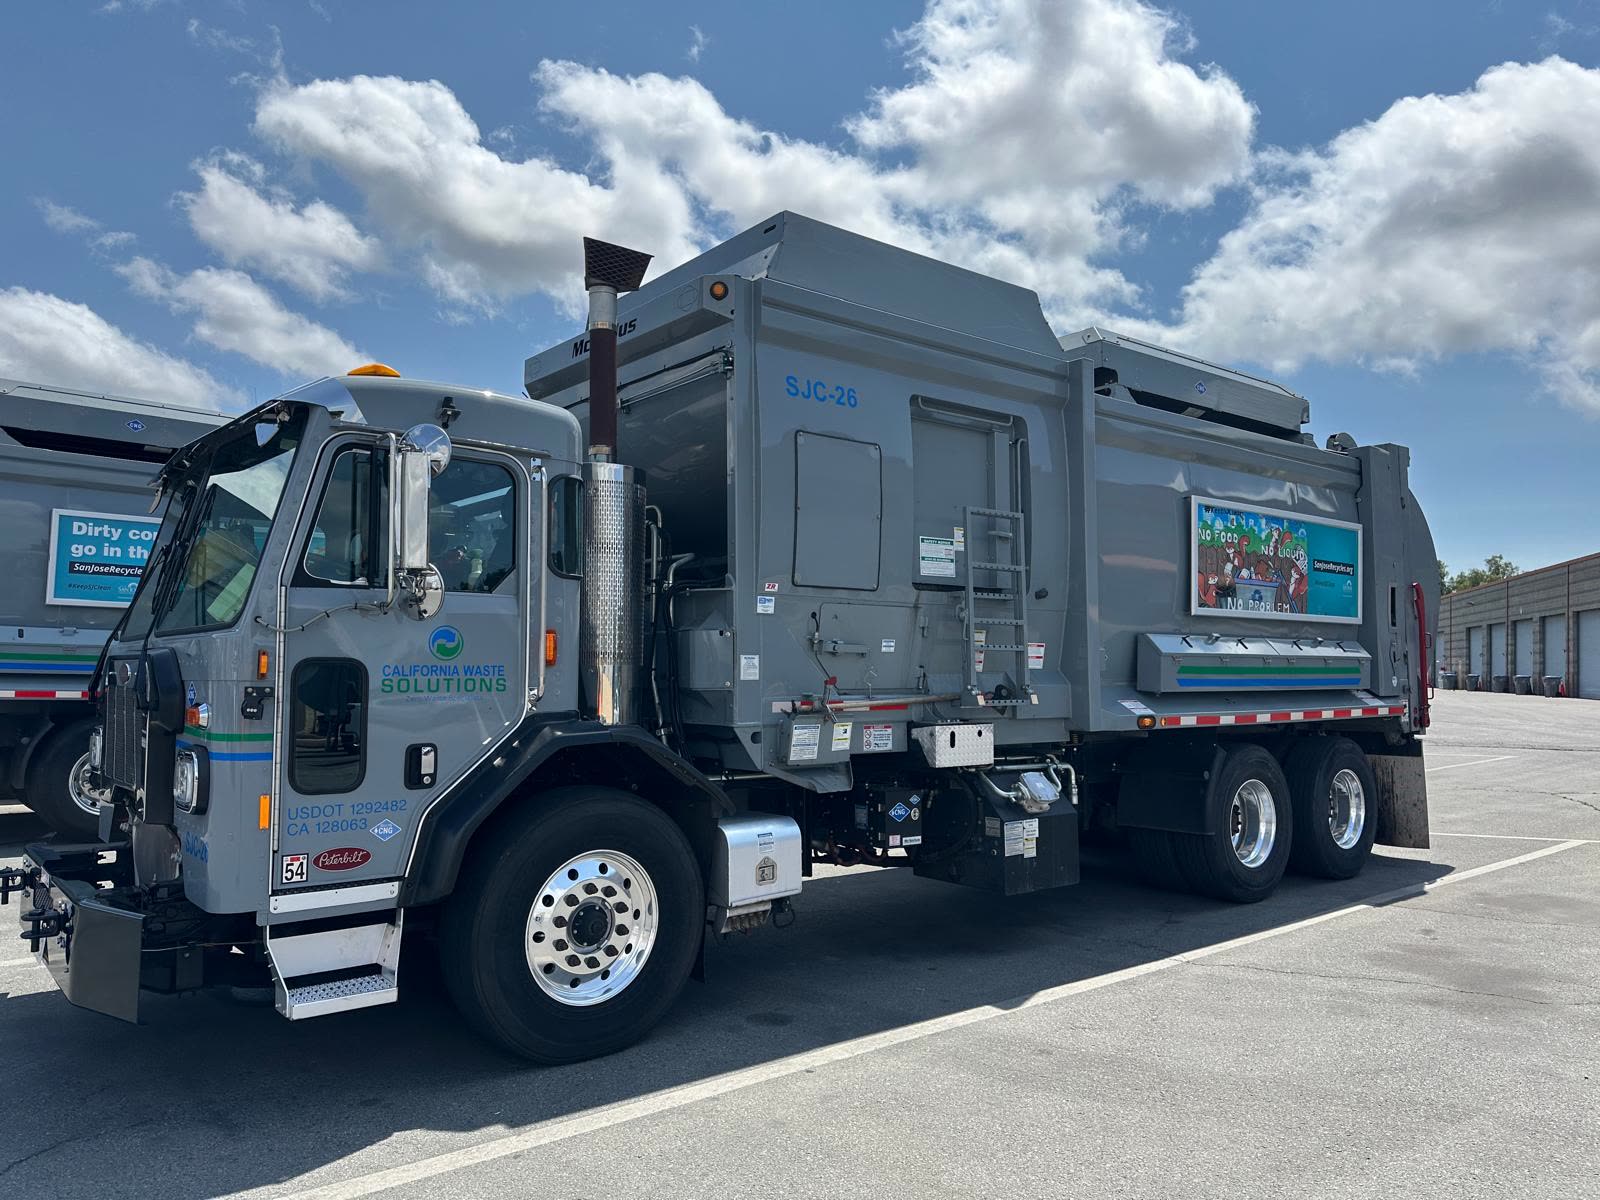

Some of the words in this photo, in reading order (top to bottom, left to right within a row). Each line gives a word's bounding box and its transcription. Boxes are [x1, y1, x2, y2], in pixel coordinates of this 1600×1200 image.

[785, 375, 858, 408] SJC-26
[72, 521, 122, 541] Dirty
[1199, 528, 1212, 541] NO
[1214, 530, 1239, 544] FOOD
[71, 543, 97, 558] go
[103, 543, 121, 557] in
[1261, 544, 1274, 556] NO
[1278, 547, 1304, 560] LIQUID
[1227, 597, 1243, 610] NO
[1248, 600, 1290, 614] PROBLEM
[382, 665, 460, 677] CALIFORNIA
[463, 665, 505, 677] WASTE
[381, 678, 507, 693] SOLUTIONS
[287, 804, 344, 820] USDOT
[350, 800, 407, 816] 1292482
[894, 808, 906, 816] CNG
[287, 823, 310, 837] CA
[316, 818, 368, 834] 128063
[378, 827, 393, 835] CNG
[319, 851, 367, 867] Peterbilt
[284, 861, 305, 881] 54
